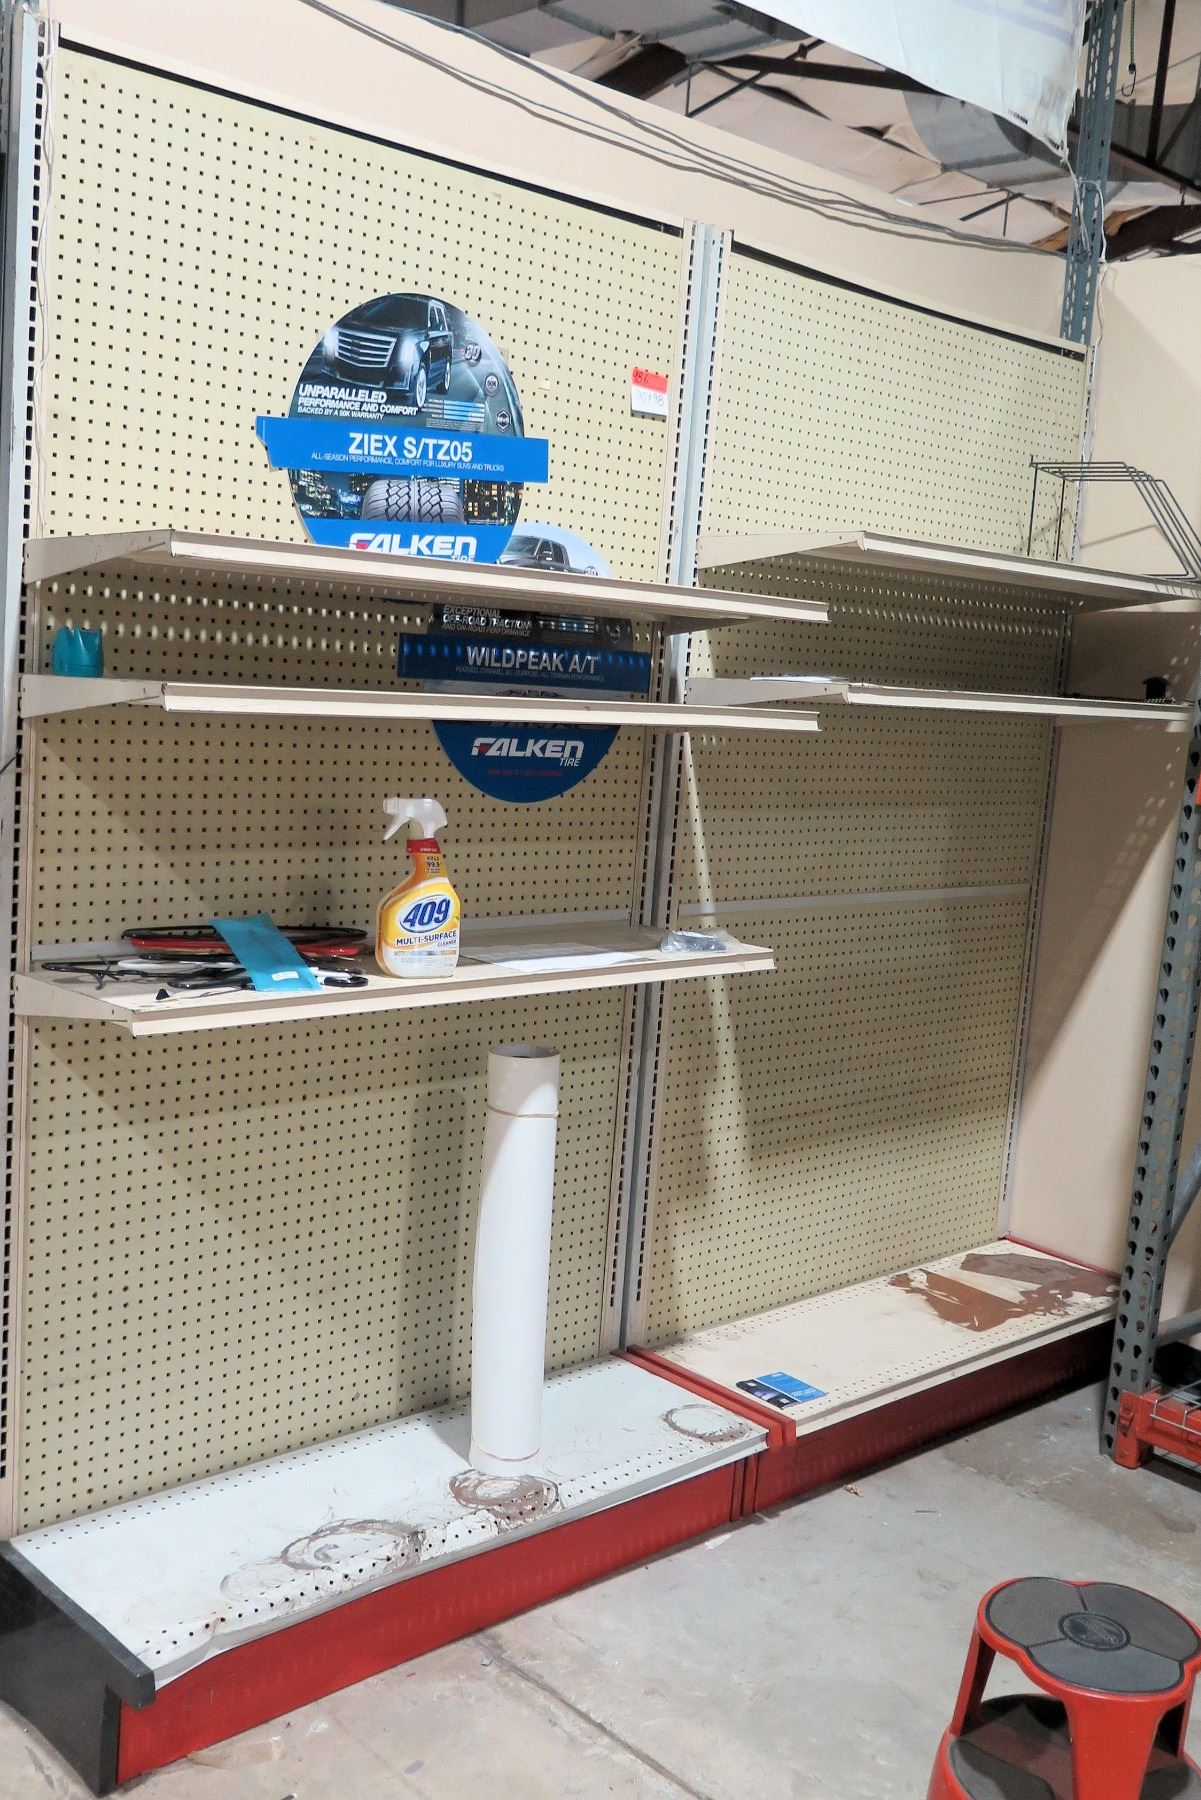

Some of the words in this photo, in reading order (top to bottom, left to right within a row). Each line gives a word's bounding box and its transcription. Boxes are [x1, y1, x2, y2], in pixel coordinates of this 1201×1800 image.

[298, 384, 387, 403] UNPARALLELED
[297, 406, 323, 415] BACKED
[324, 408, 333, 416] BY
[351, 411, 384, 420] WARRANTY
[298, 397, 360, 411] PERFORMANCE
[361, 403, 378, 412] AND
[380, 404, 418, 416] COMFORT
[348, 432, 398, 457] ZIEX
[403, 436, 473, 463] S/TZ05
[311, 452, 349, 462] ALL-SEASON
[349, 455, 393, 465] PERFORMANCE,
[394, 458, 422, 467] COMFORT
[435, 461, 457, 469] LUXURY
[472, 463, 484, 471] AND
[484, 464, 505, 472] TRUCKS
[350, 532, 478, 558] FALKEN
[443, 605, 501, 618] EXCEPTIONAL
[442, 623, 456, 631] AND
[457, 624, 486, 633] ON-ROAD
[486, 627, 531, 637] PERFORMANCE
[443, 614, 487, 626] OFF-ROAD
[489, 617, 531, 630] TRACTION
[466, 645, 564, 672] WILDPEAK
[568, 653, 599, 674] A/T
[471, 737, 584, 759] FALKEN
[560, 757, 580, 767] TIRE
[403, 899, 451, 927] 409
[396, 930, 457, 946] MULTI-SURFACE
[437, 939, 457, 947] CLEANER
